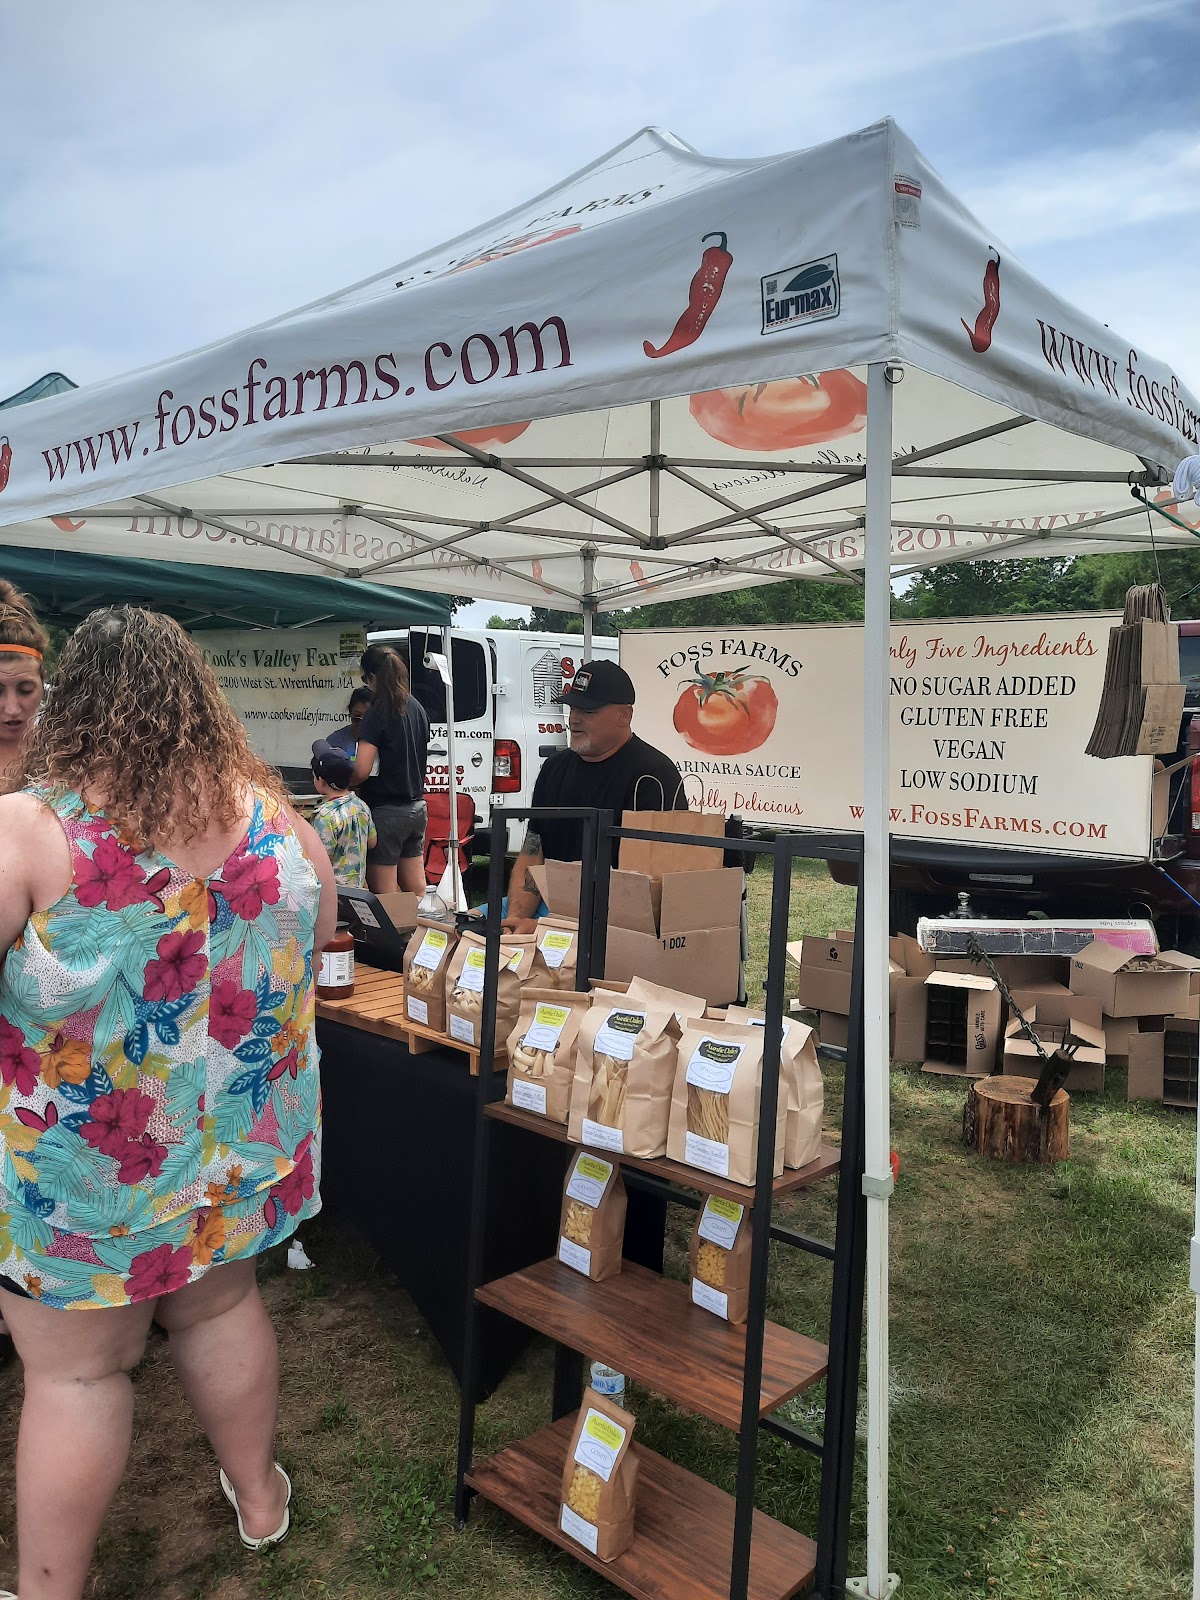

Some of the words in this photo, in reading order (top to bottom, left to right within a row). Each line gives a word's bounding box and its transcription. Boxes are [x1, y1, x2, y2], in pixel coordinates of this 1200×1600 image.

[766, 285, 833, 324] Eurmax
[1036, 318, 1200, 445] www.fossfar
[41, 315, 574, 483] www.fossfarms.com
[203, 649, 247, 668] Cook's
[253, 649, 302, 671] Valley
[305, 647, 338, 667] Far
[656, 641, 714, 678] FOSS
[719, 638, 804, 678] FARMS
[889, 636, 917, 669] nly
[925, 637, 967, 660] Five
[972, 632, 1098, 666] Ingredients
[240, 675, 263, 690] West
[264, 676, 278, 690] St.
[279, 675, 335, 691] Wrentham,
[337, 676, 355, 689] MA
[889, 676, 917, 696] NO
[922, 676, 992, 697] SUGAR
[995, 675, 1076, 697] ADDED
[900, 706, 985, 727] GLUTEN
[990, 707, 1048, 728] FREE
[933, 738, 1006, 760] VEGAN
[674, 760, 743, 776] ARINARA
[745, 763, 801, 779] SAUCE
[900, 769, 947, 790] LOW
[949, 771, 1039, 795] SODIUM
[733, 791, 804, 816] Delicious
[662, 939, 666, 951] 1
[670, 936, 686, 950] DOZ
